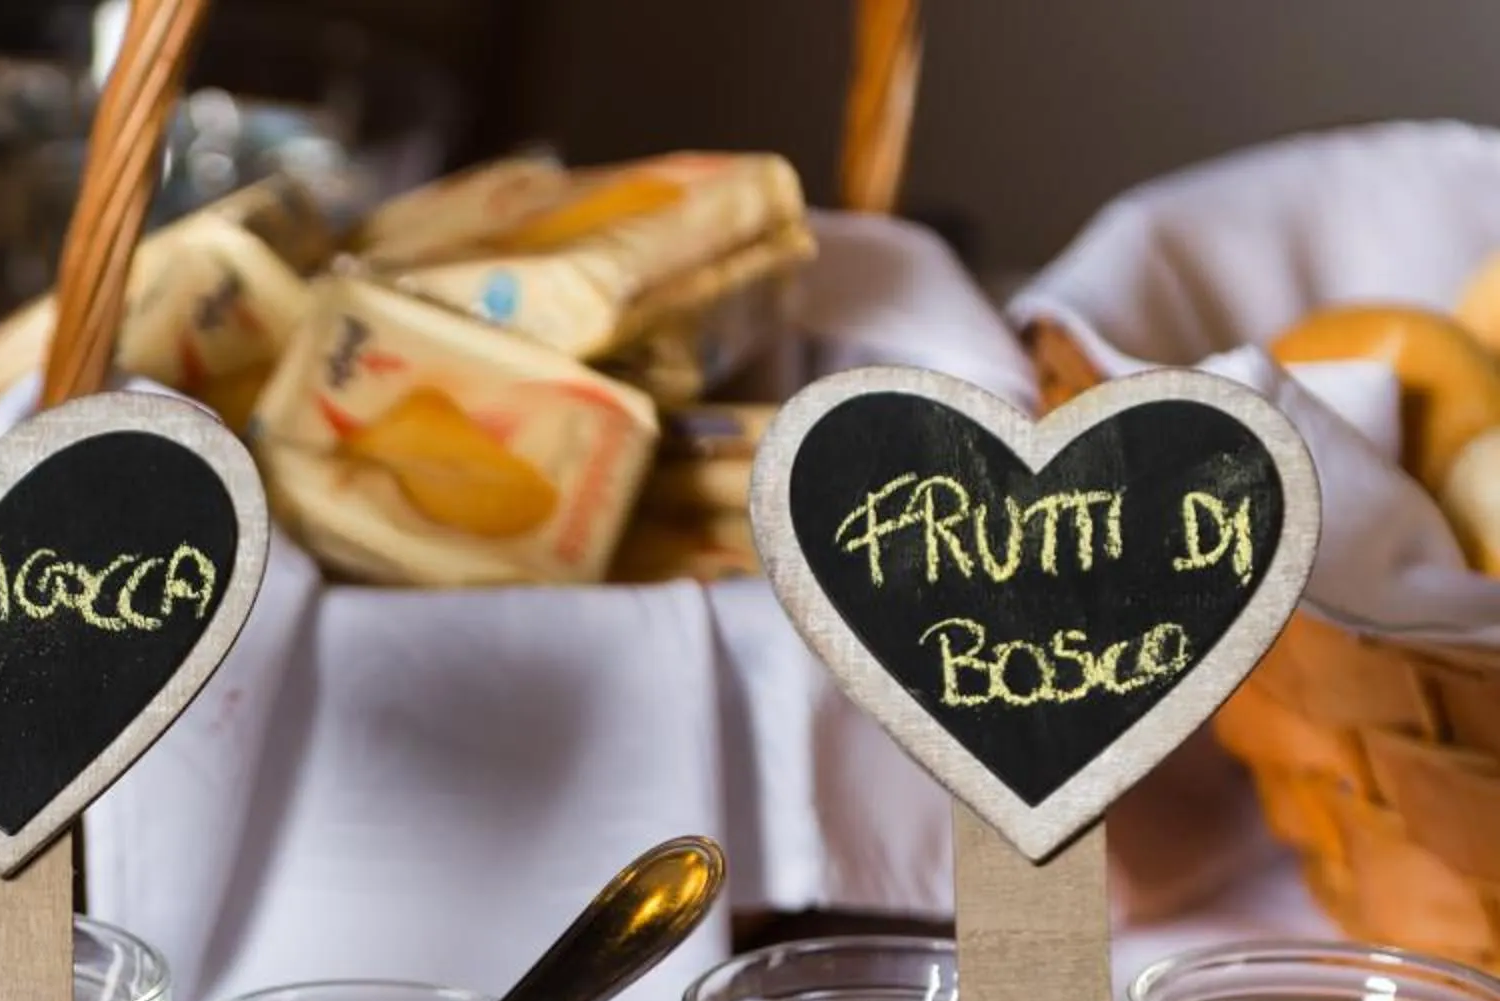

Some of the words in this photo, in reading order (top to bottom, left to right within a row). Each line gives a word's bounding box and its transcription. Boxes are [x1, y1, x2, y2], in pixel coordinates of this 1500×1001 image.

[835, 472, 1125, 585] FRUTTI
[1173, 490, 1254, 586] DI
[919, 617, 1190, 707] BOSCO
